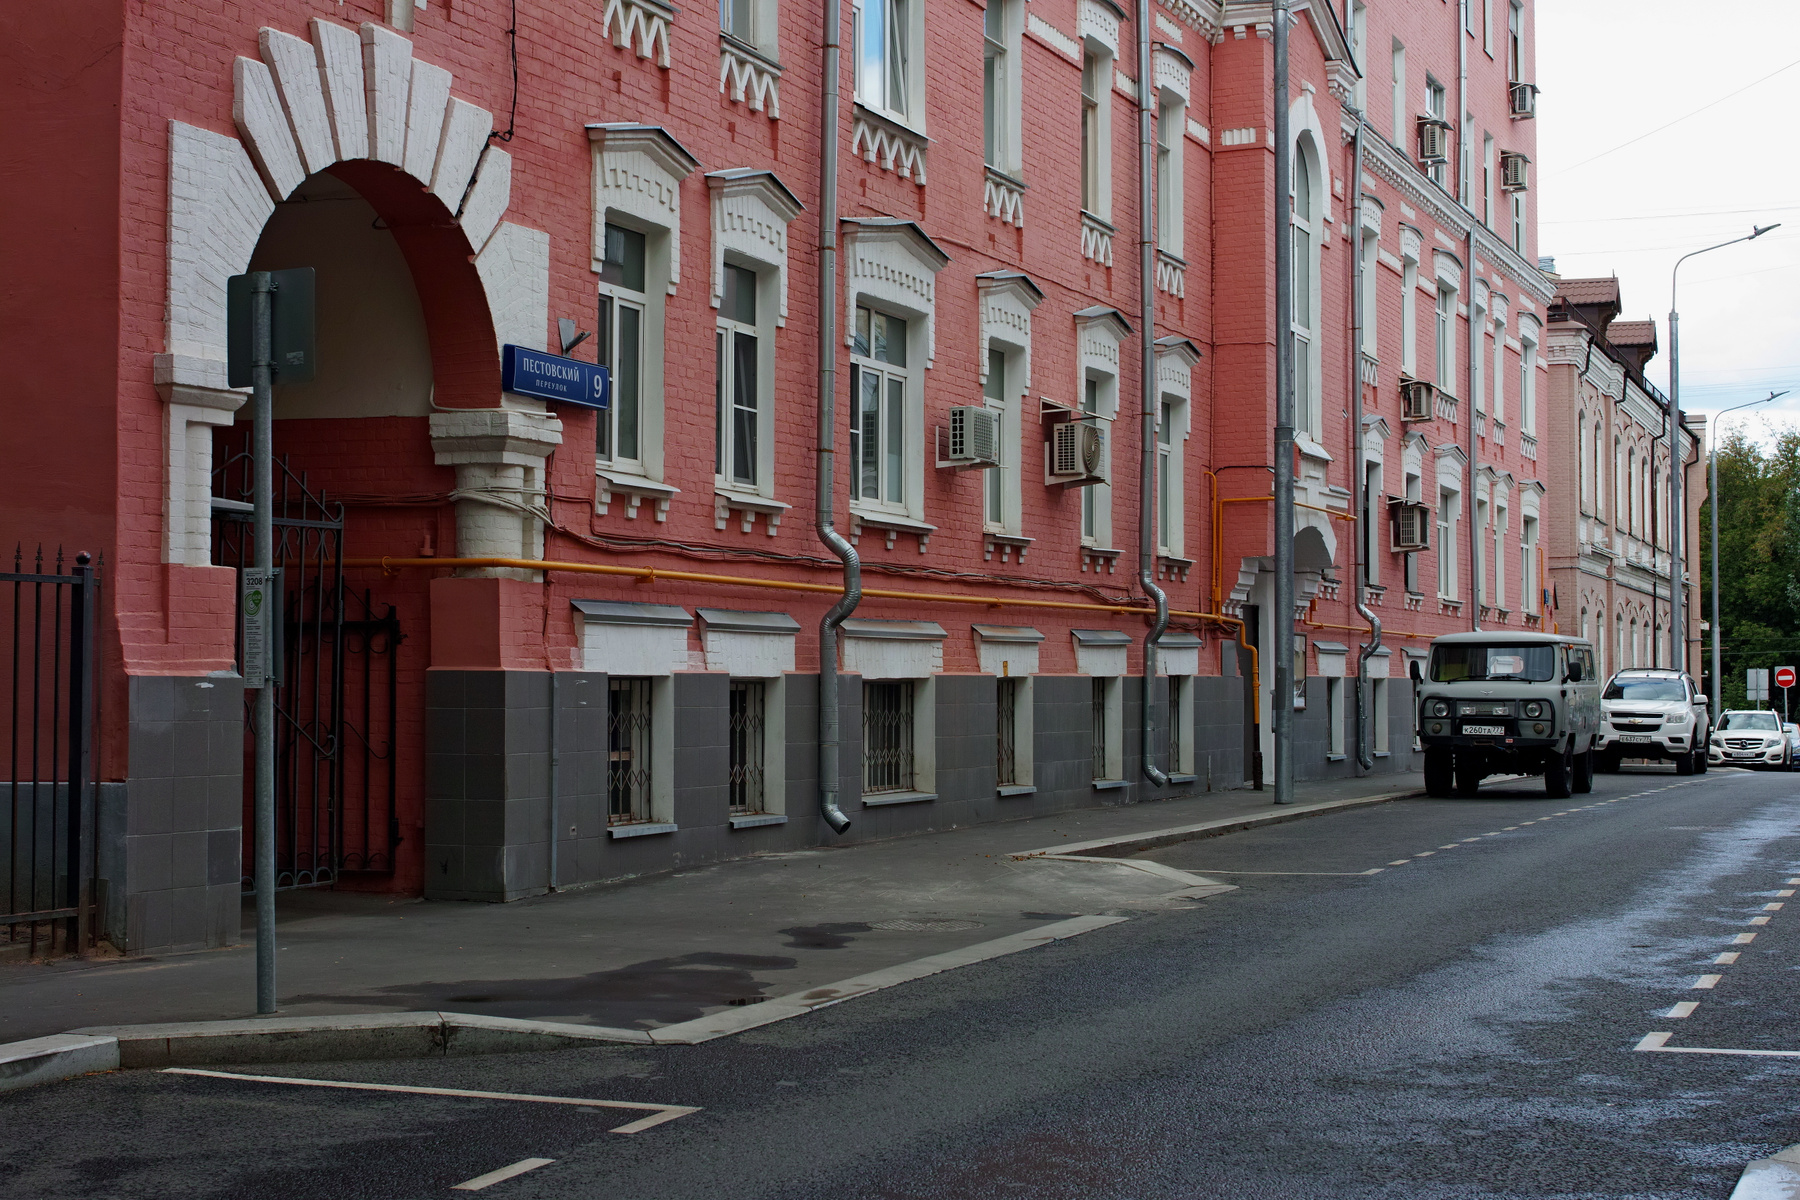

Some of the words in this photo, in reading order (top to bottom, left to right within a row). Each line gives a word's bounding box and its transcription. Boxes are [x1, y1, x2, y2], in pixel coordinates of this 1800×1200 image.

[523, 357, 580, 383] ПЕСТОВСКИЙ
[535, 379, 567, 392] ПЕРЕУЛОК
[593, 374, 603, 398] 9
[246, 577, 263, 586] 3208
